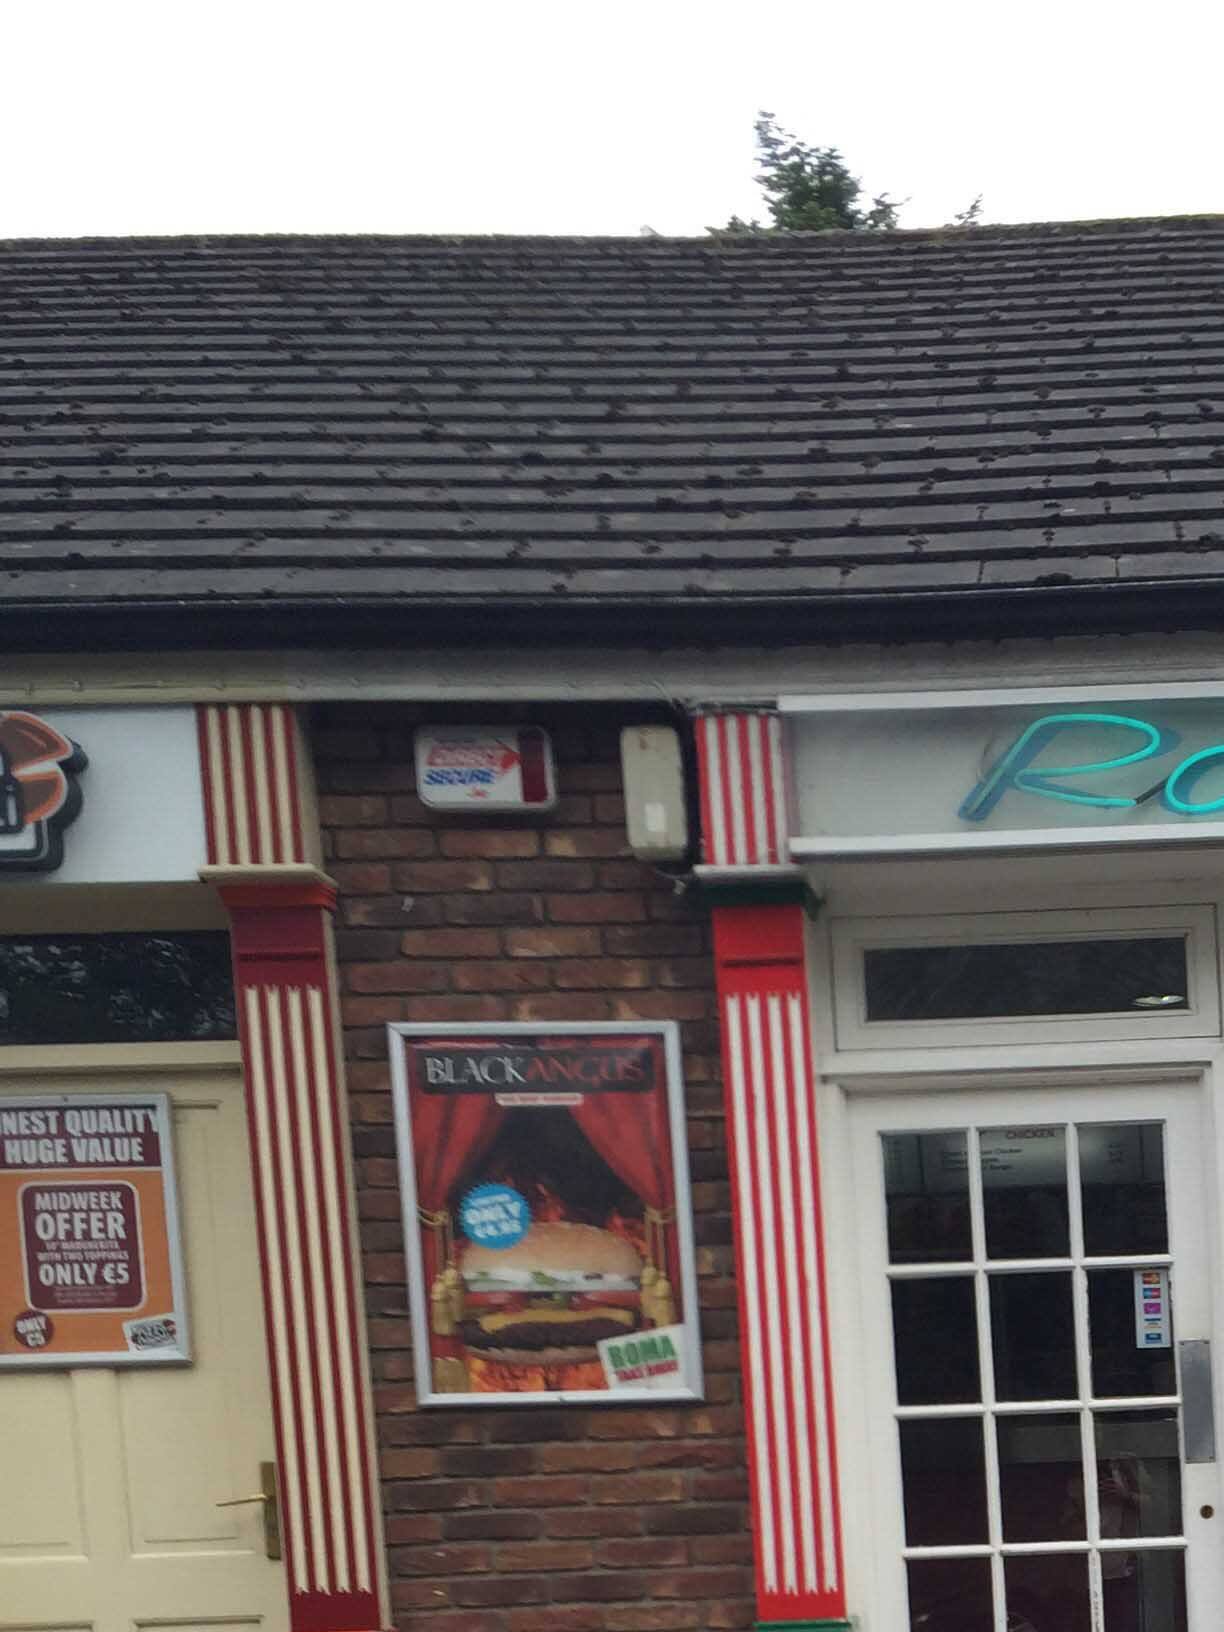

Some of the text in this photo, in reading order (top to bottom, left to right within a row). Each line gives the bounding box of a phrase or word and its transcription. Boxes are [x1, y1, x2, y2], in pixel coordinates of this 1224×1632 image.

[0, 1109, 60, 1136] NEST
[4, 1136, 144, 1164] HUGE VALUE
[34, 1190, 124, 1212] MIDWEEK
[34, 1210, 127, 1241] OFFER
[39, 1262, 130, 1287] ONLY €5
[608, 1335, 676, 1371] ROMA
